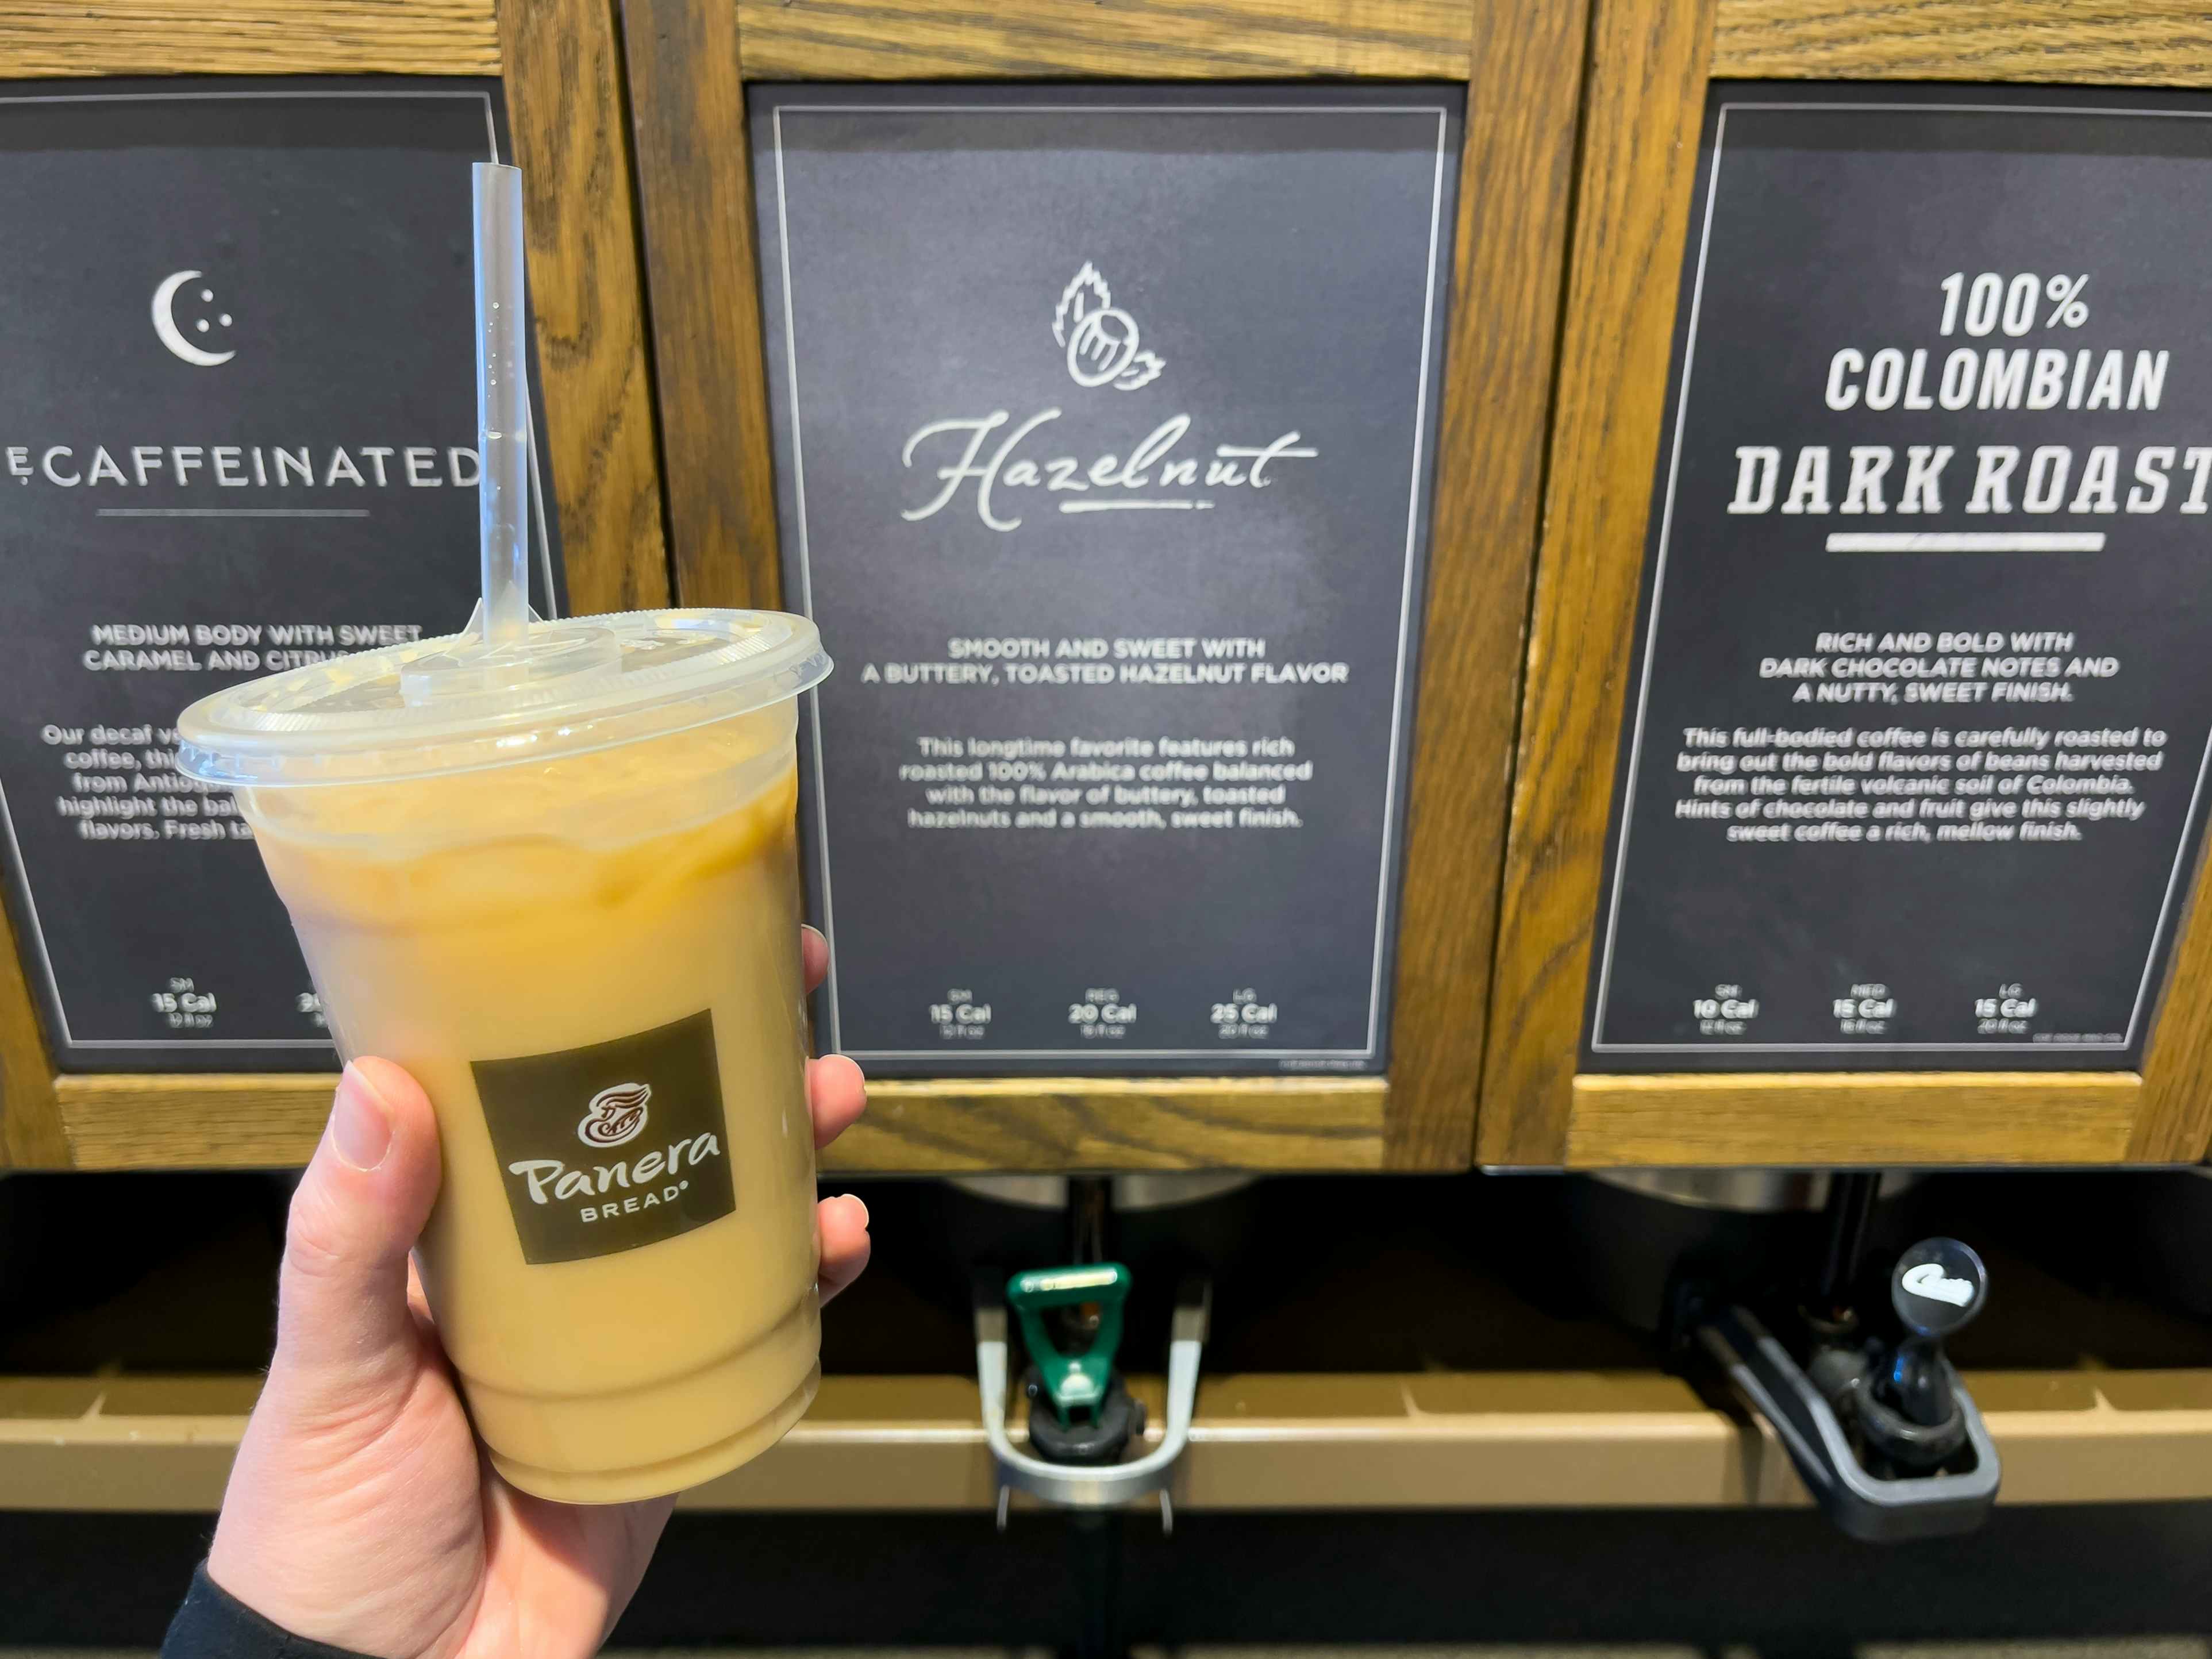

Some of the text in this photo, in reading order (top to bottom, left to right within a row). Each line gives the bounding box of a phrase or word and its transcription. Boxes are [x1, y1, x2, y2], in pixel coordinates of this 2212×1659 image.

[1939, 271, 2091, 337] 100%
[1824, 348, 2169, 411] COLOMBIAN
[901, 406, 1319, 532] Hazelnut
[1726, 445, 2212, 515] DARK ROAST
[91, 625, 423, 646] MEDIUM BODY WITH SWEET
[1815, 633, 2074, 653] RICH AND BOLD WITH
[948, 637, 1265, 659] SMOOTH AND SWEET WITH
[83, 649, 202, 671] CARAMEL
[209, 649, 260, 671] AND
[1759, 657, 2121, 678] DARK CHOCOLATE NOTES AND
[861, 663, 1349, 686] A BUTTERY, TOASTED HAZELNUT FLAVOR
[1792, 682, 2074, 706] A NUTTY, SWEET FINISH.
[41, 724, 84, 745] Our
[89, 724, 153, 745] decaf
[1683, 728, 2168, 750] This full-bodied coffee is carefully roasted to
[916, 736, 1295, 760] This longtime favorite features rich
[64, 749, 141, 771] coffee,
[899, 761, 1313, 781] roasted 100% Arabica coffee balanced
[1676, 751, 2165, 775] bring out the bold flavors of beans harvested
[72, 772, 128, 793] from
[1694, 775, 2136, 795] from the fertile volcanic soil of Colombia.
[925, 784, 1286, 808] with the flavor of buttery, toasted
[56, 796, 157, 819] highlight
[160, 796, 198, 817] the
[907, 807, 1304, 829] hazelnuts and a smooth, sweet finish.
[1675, 798, 2146, 821] Hints of chocolate and fruit give this slightly
[79, 820, 160, 841] flavors.
[163, 819, 226, 840] Fresh
[1726, 822, 2083, 844] sweet coffee a rich, mellow finish.
[151, 992, 217, 1013] 15 Cal
[1068, 1003, 1137, 1024] 20 Cal
[1210, 1003, 1278, 1023] 25 Cal
[1693, 999, 1759, 1019] 10 Cal
[1833, 999, 1896, 1018] 15 Cal
[1975, 998, 2038, 1018] 15 Cal
[929, 1004, 992, 1024] 15 Cal
[509, 1132, 720, 1205] Panera
